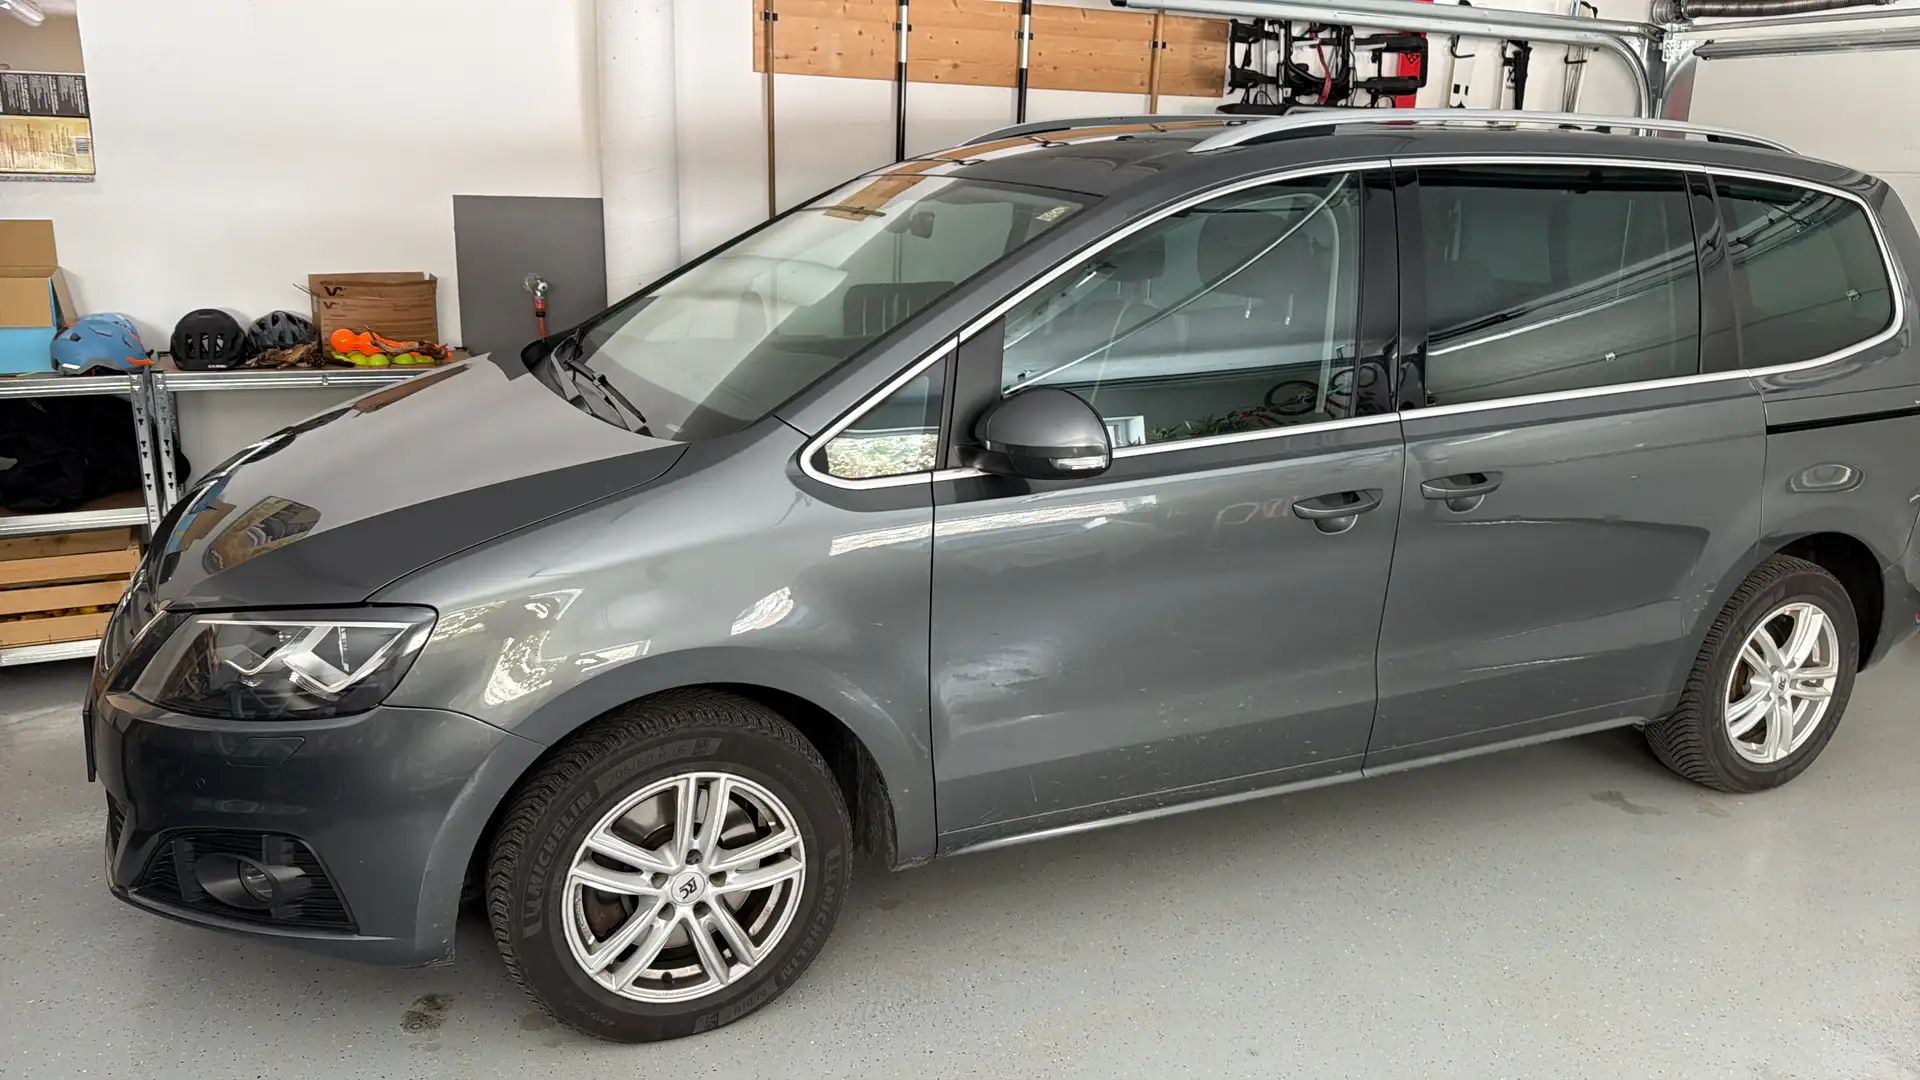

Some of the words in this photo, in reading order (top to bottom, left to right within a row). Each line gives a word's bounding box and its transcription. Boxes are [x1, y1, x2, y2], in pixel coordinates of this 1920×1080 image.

[527, 790, 593, 896] MICHELIN
[607, 754, 654, 784] 205/60
[679, 876, 698, 900] RC
[781, 885, 835, 981] MICHELIN
